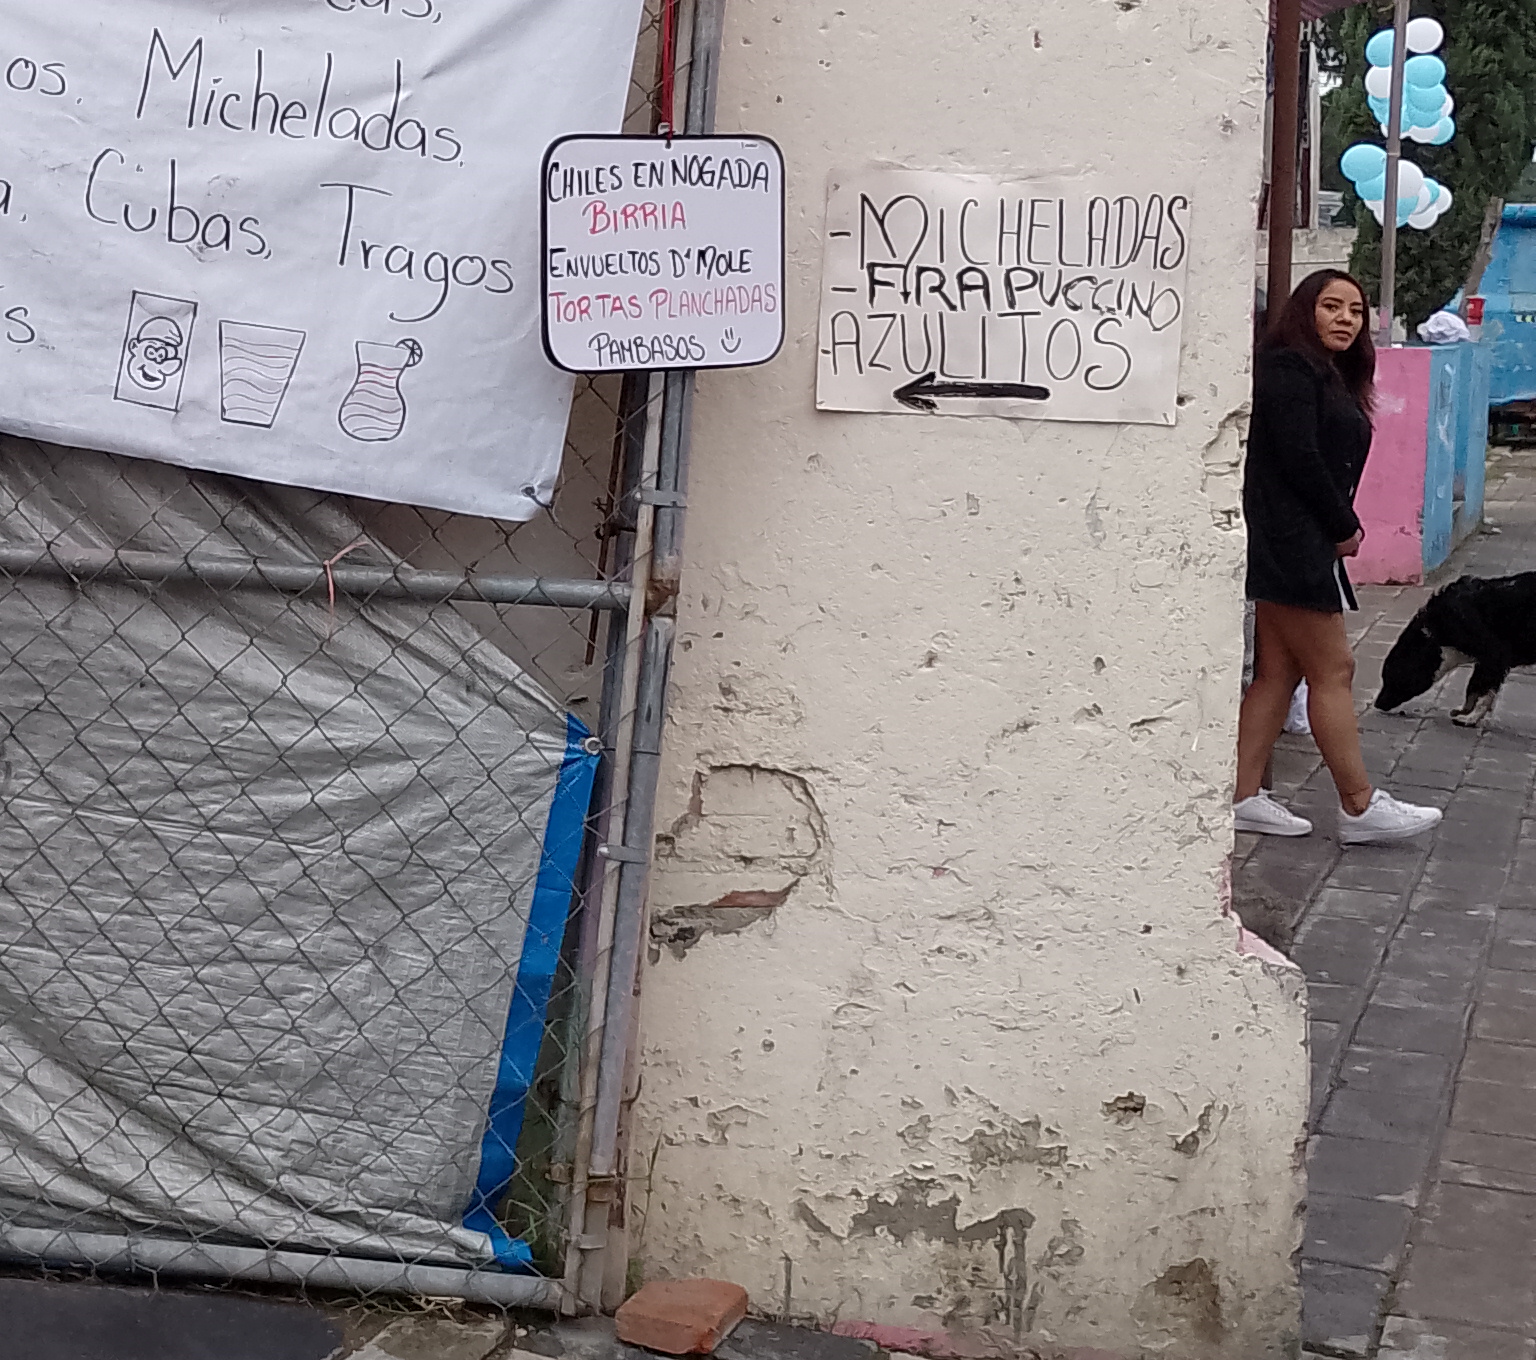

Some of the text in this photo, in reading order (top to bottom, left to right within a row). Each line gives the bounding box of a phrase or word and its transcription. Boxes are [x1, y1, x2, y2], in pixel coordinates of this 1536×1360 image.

[548, 154, 770, 203] CHILES EN NOGADA
[582, 199, 687, 236] BIRRIA
[319, 180, 518, 324] Tragos
[549, 248, 662, 279] ENVUELTOS
[549, 282, 778, 323] TORTAS PLANCHADAS
[588, 332, 707, 368] PAMBASOS
